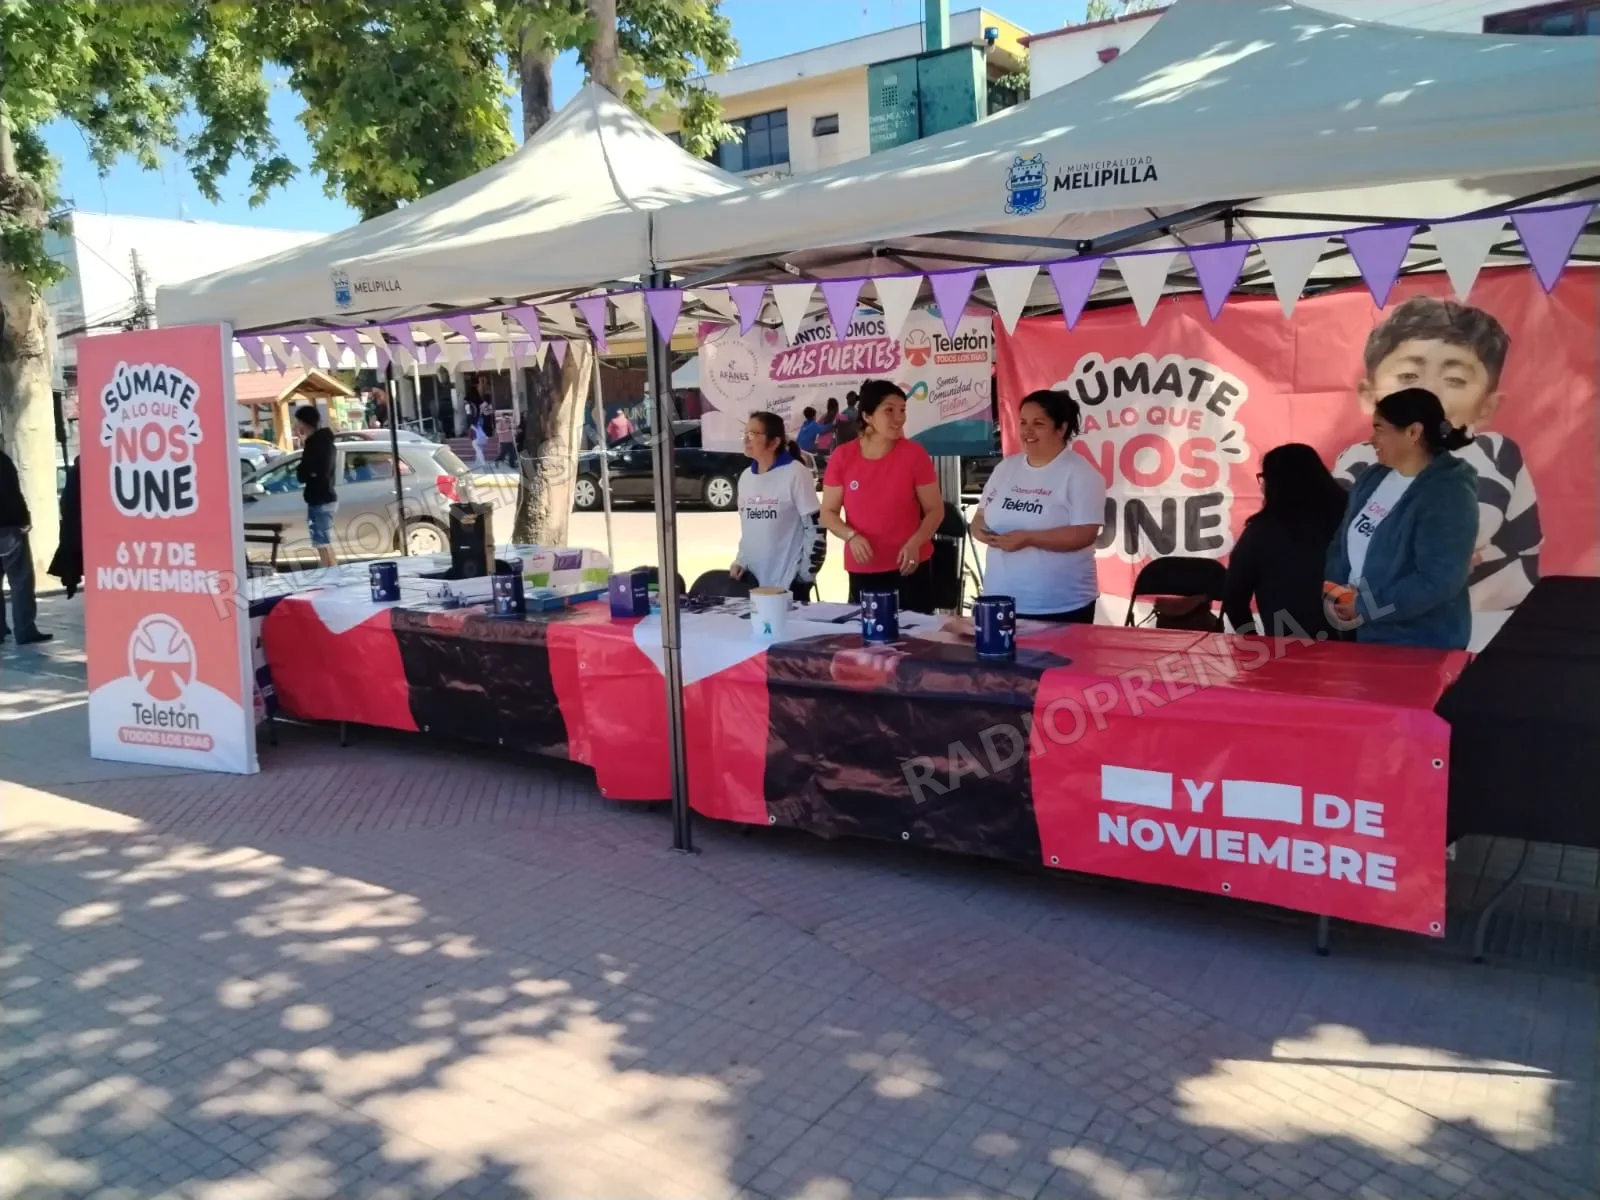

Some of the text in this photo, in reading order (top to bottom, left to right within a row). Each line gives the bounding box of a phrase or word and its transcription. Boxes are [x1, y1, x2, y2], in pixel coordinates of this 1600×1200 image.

[1066, 155, 1153, 174] MUNICIPALIDAD
[1053, 165, 1158, 192] MELIPILLA
[353, 279, 402, 294] MELIPILLA
[844, 320, 886, 338] OMOS
[932, 327, 988, 353] Teletón
[775, 344, 817, 377] MÁS
[818, 339, 896, 373] FUERTES
[719, 369, 749, 381] AFANES
[936, 375, 959, 390] Somos
[1074, 360, 1240, 417] ÚMATE
[105, 367, 196, 414] SÚMATE
[929, 377, 973, 404] Comunidad
[121, 401, 179, 423] A LO QUE
[1083, 405, 1205, 435] A LO QUE
[115, 421, 189, 465] NOS
[114, 465, 194, 513] UNE
[116, 541, 197, 567] 6 Y 7 DE
[96, 566, 221, 595] NOVIEMBRE
[131, 702, 200, 730] Teletón
[1180, 778, 1386, 838] Y DE
[1098, 812, 1397, 892] NOVIEMBRE
